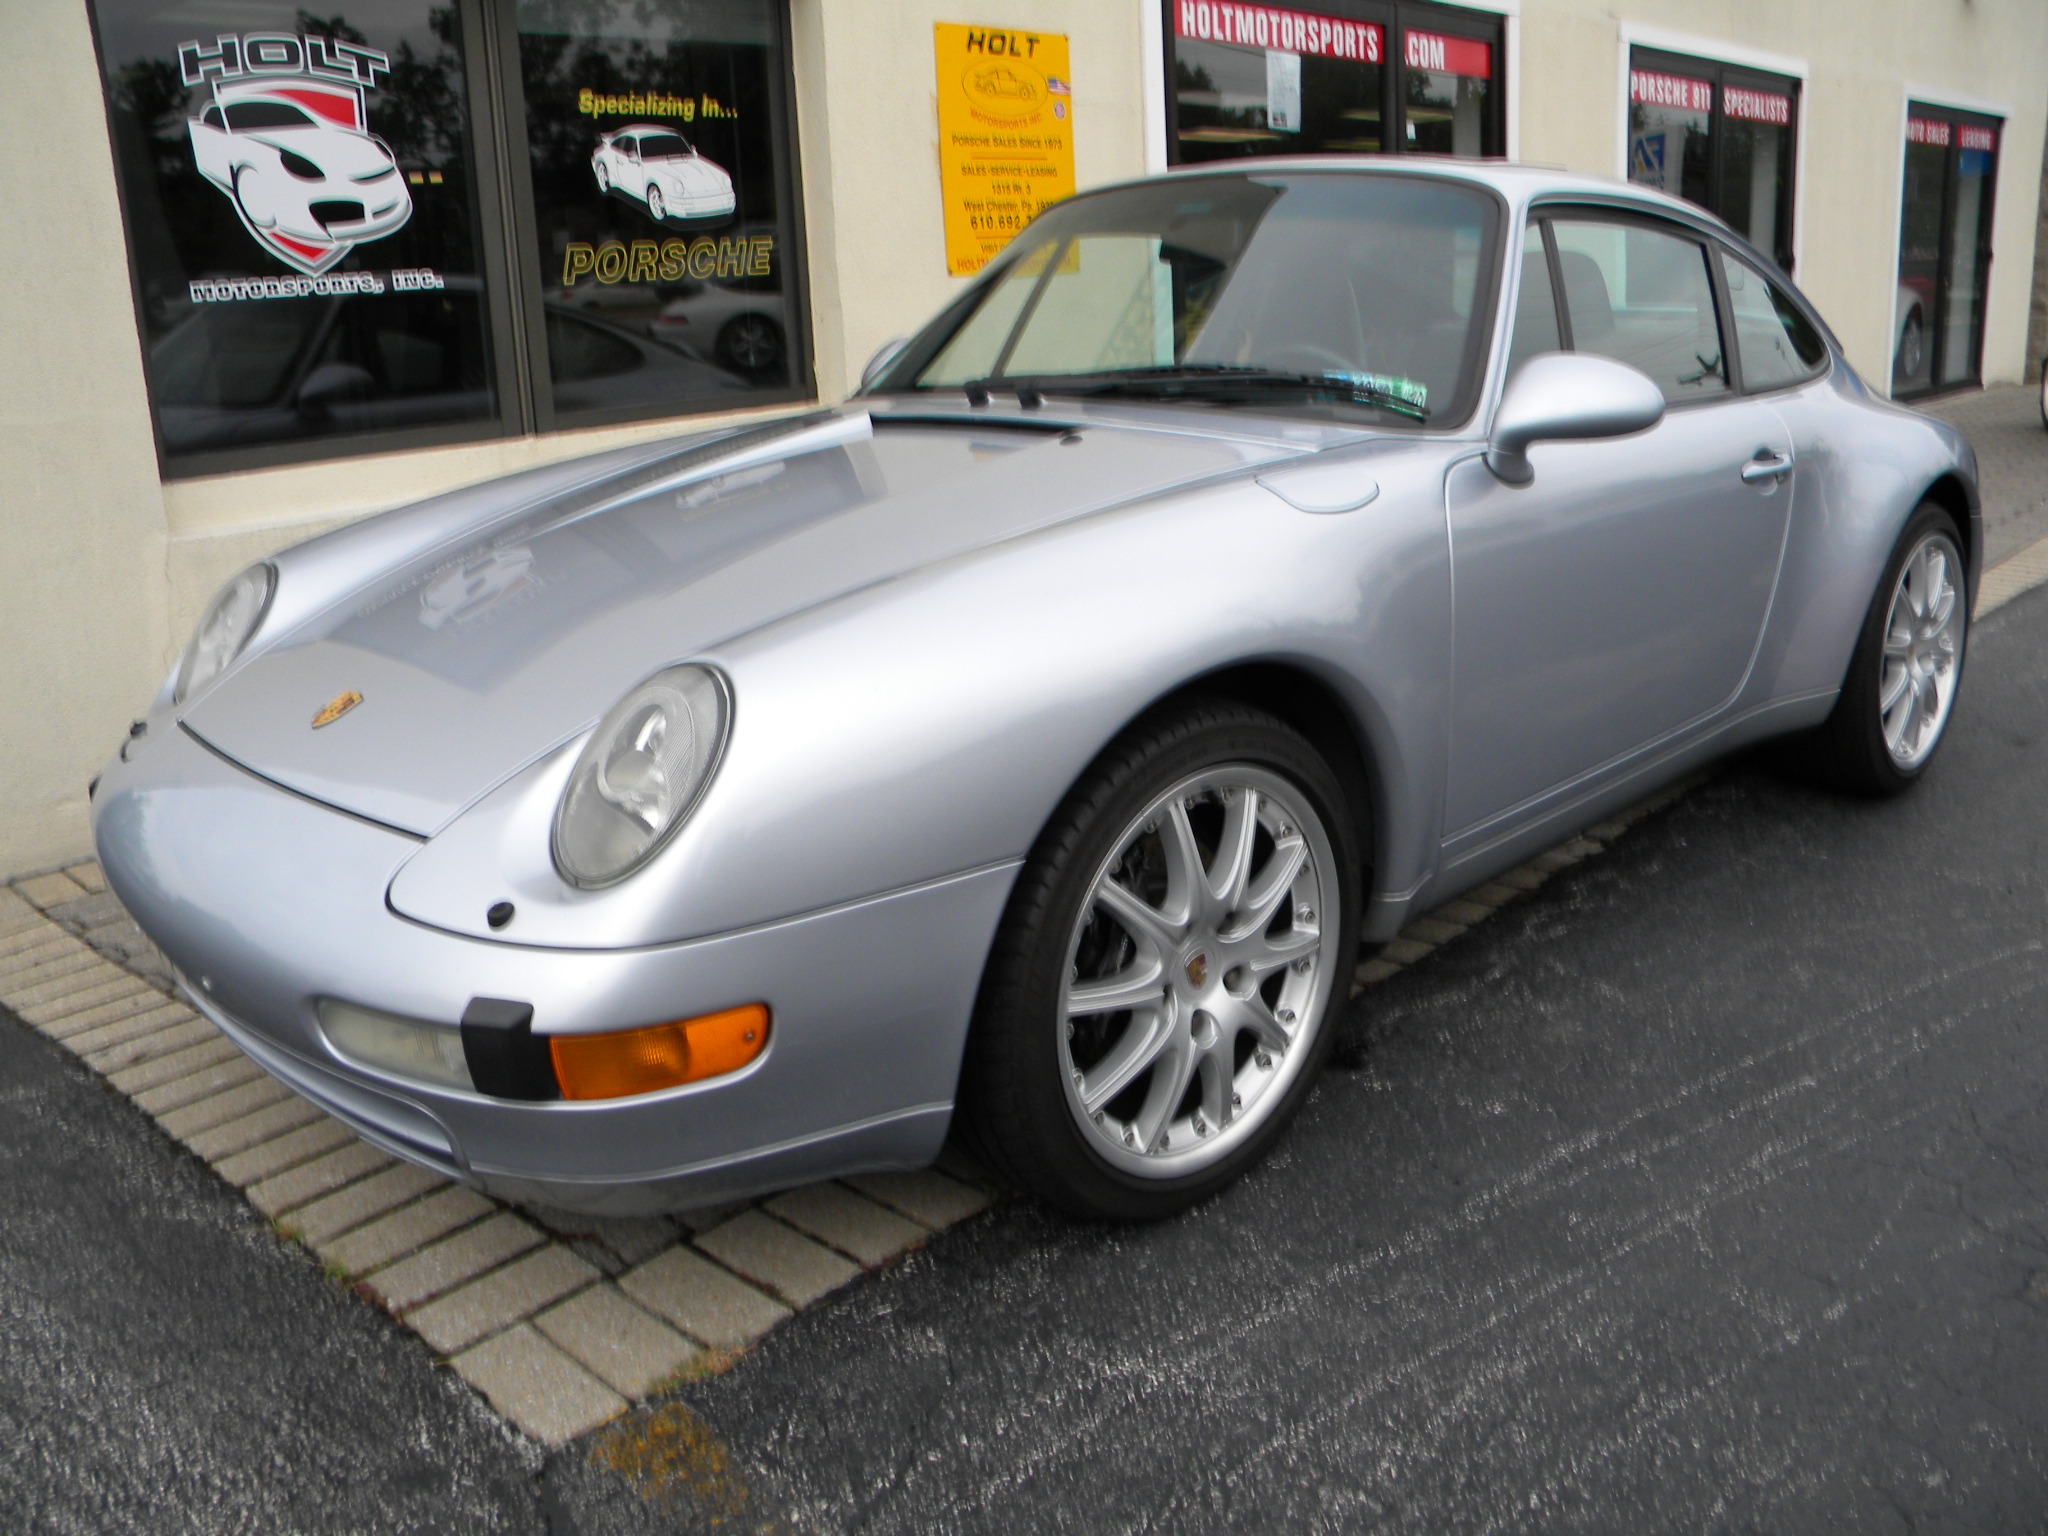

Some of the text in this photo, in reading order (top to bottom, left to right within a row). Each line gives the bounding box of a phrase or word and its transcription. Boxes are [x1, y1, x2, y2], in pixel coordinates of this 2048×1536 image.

[967, 29, 1040, 58] HOLT
[1180, 0, 1379, 62] HOLTMOTORSPORTS
[177, 31, 391, 88] HOLT
[578, 88, 696, 121] Specializing
[1631, 71, 1712, 111] PORSCHE 911
[1723, 88, 1788, 123] SPECIALISTS
[970, 107, 1029, 130] MOTORSPORTS
[952, 133, 990, 147] PORSCHE
[992, 134, 1017, 148] SALES
[1019, 136, 1042, 149] SINCE
[1960, 126, 1991, 150] LEASING
[963, 199, 984, 212] West
[562, 235, 774, 286] PORSCHE
[188, 267, 445, 304] MOTORSPORTS, INC.
